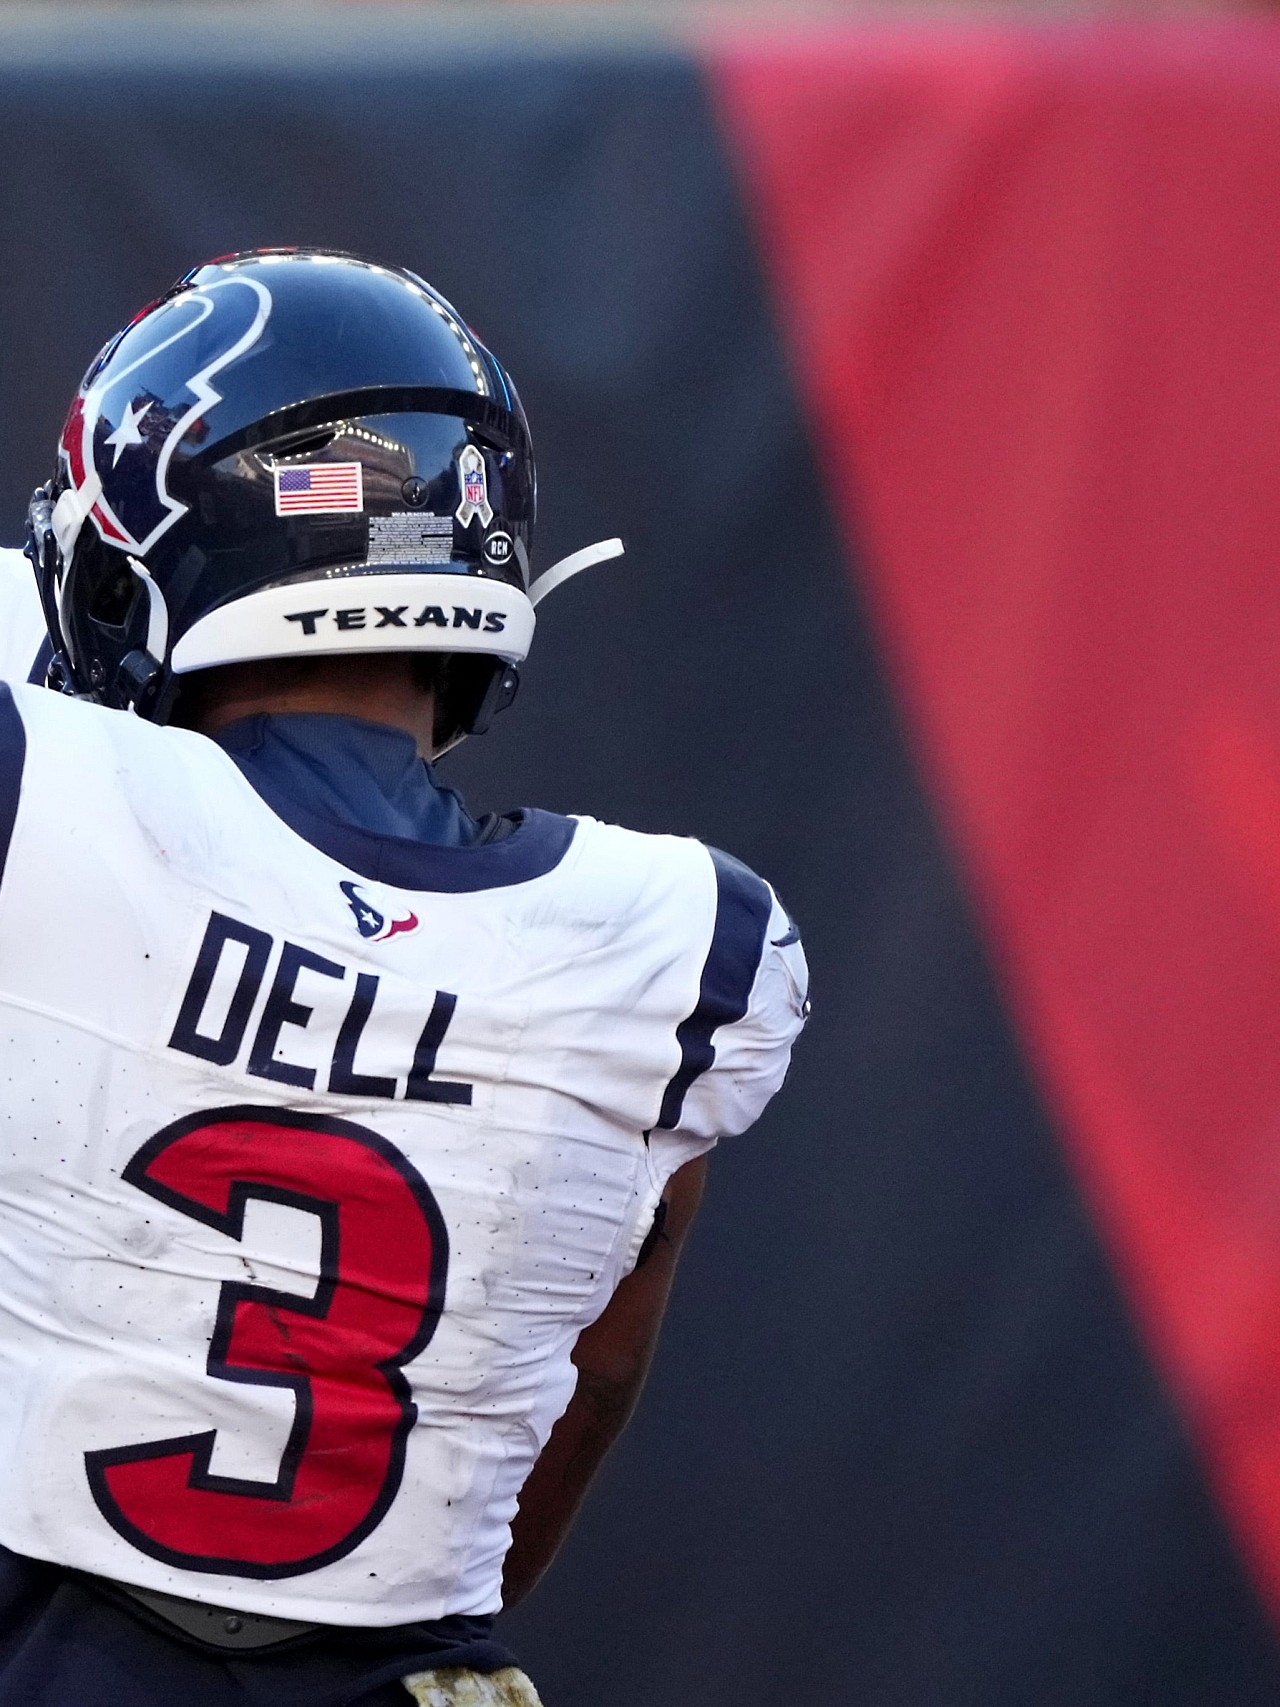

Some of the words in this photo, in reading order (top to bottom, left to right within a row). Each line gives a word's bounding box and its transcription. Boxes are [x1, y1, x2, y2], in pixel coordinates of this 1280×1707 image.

[467, 485, 484, 502] NFL
[284, 605, 508, 636] TEXANS
[168, 910, 474, 1106] DELL
[84, 1103, 450, 1580] 3
